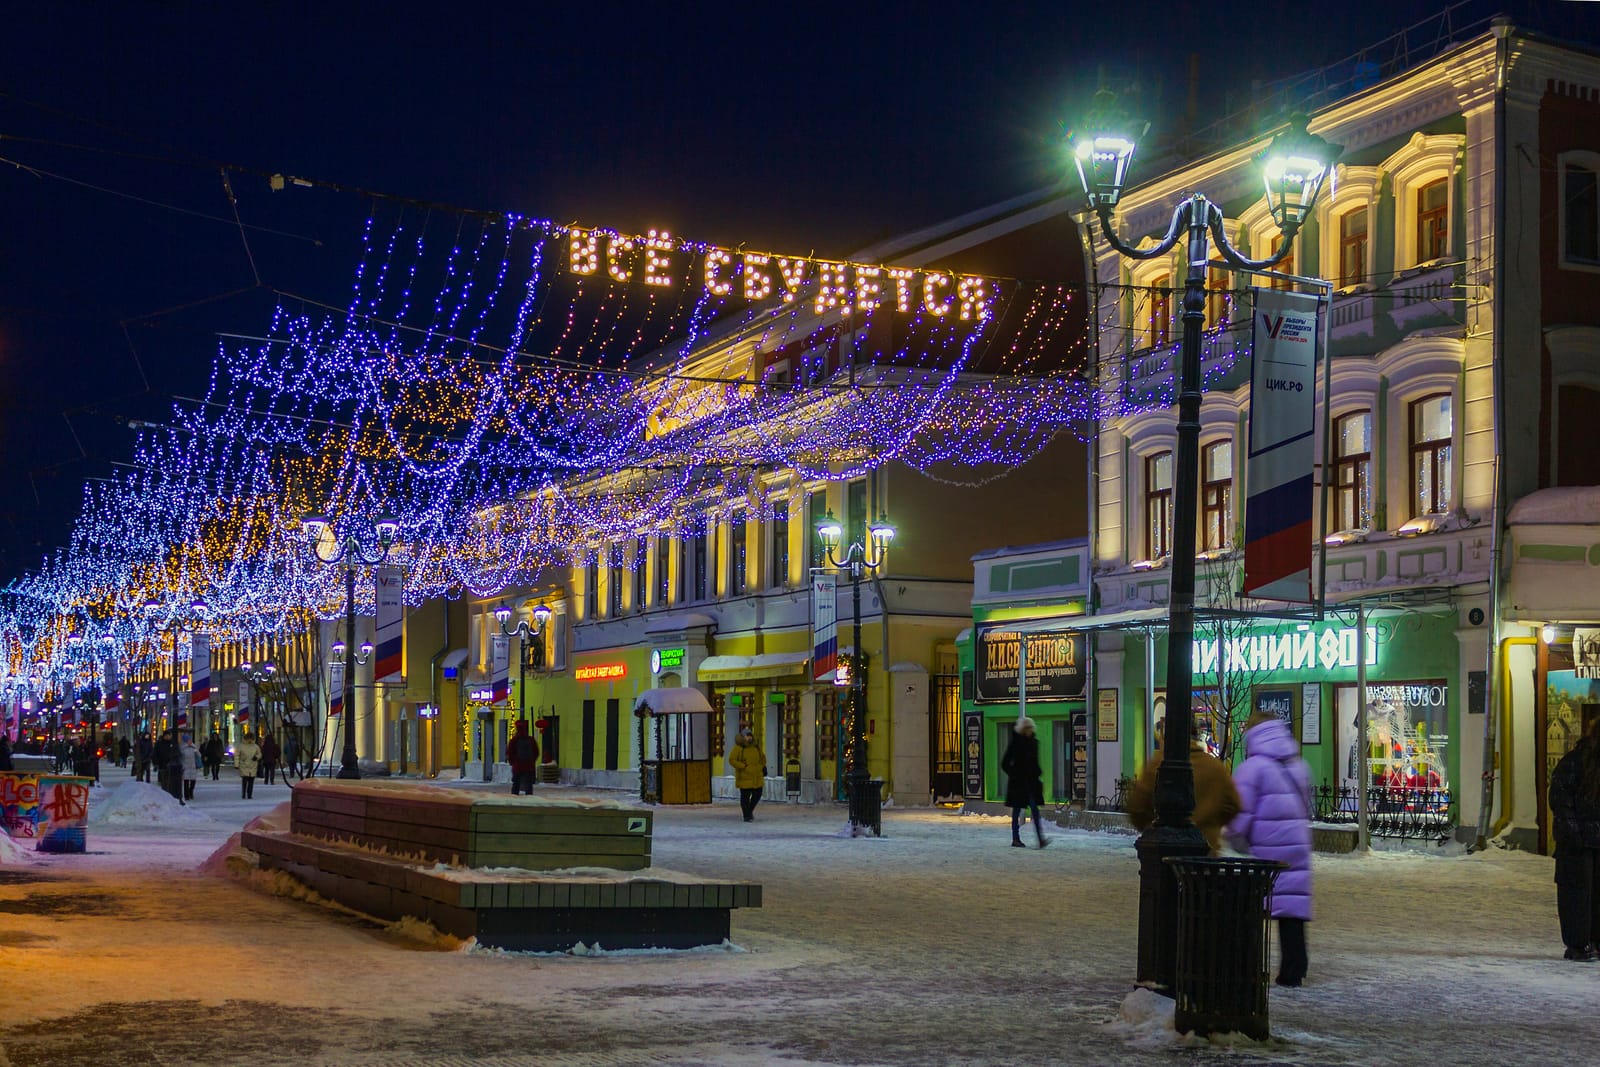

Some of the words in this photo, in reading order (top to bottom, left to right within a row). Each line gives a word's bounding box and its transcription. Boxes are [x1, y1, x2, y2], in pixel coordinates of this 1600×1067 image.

[569, 227, 673, 286] ВСЁ
[704, 249, 986, 321] СБУДЕТСЯ
[1266, 378, 1303, 392] ЦИК.РФ
